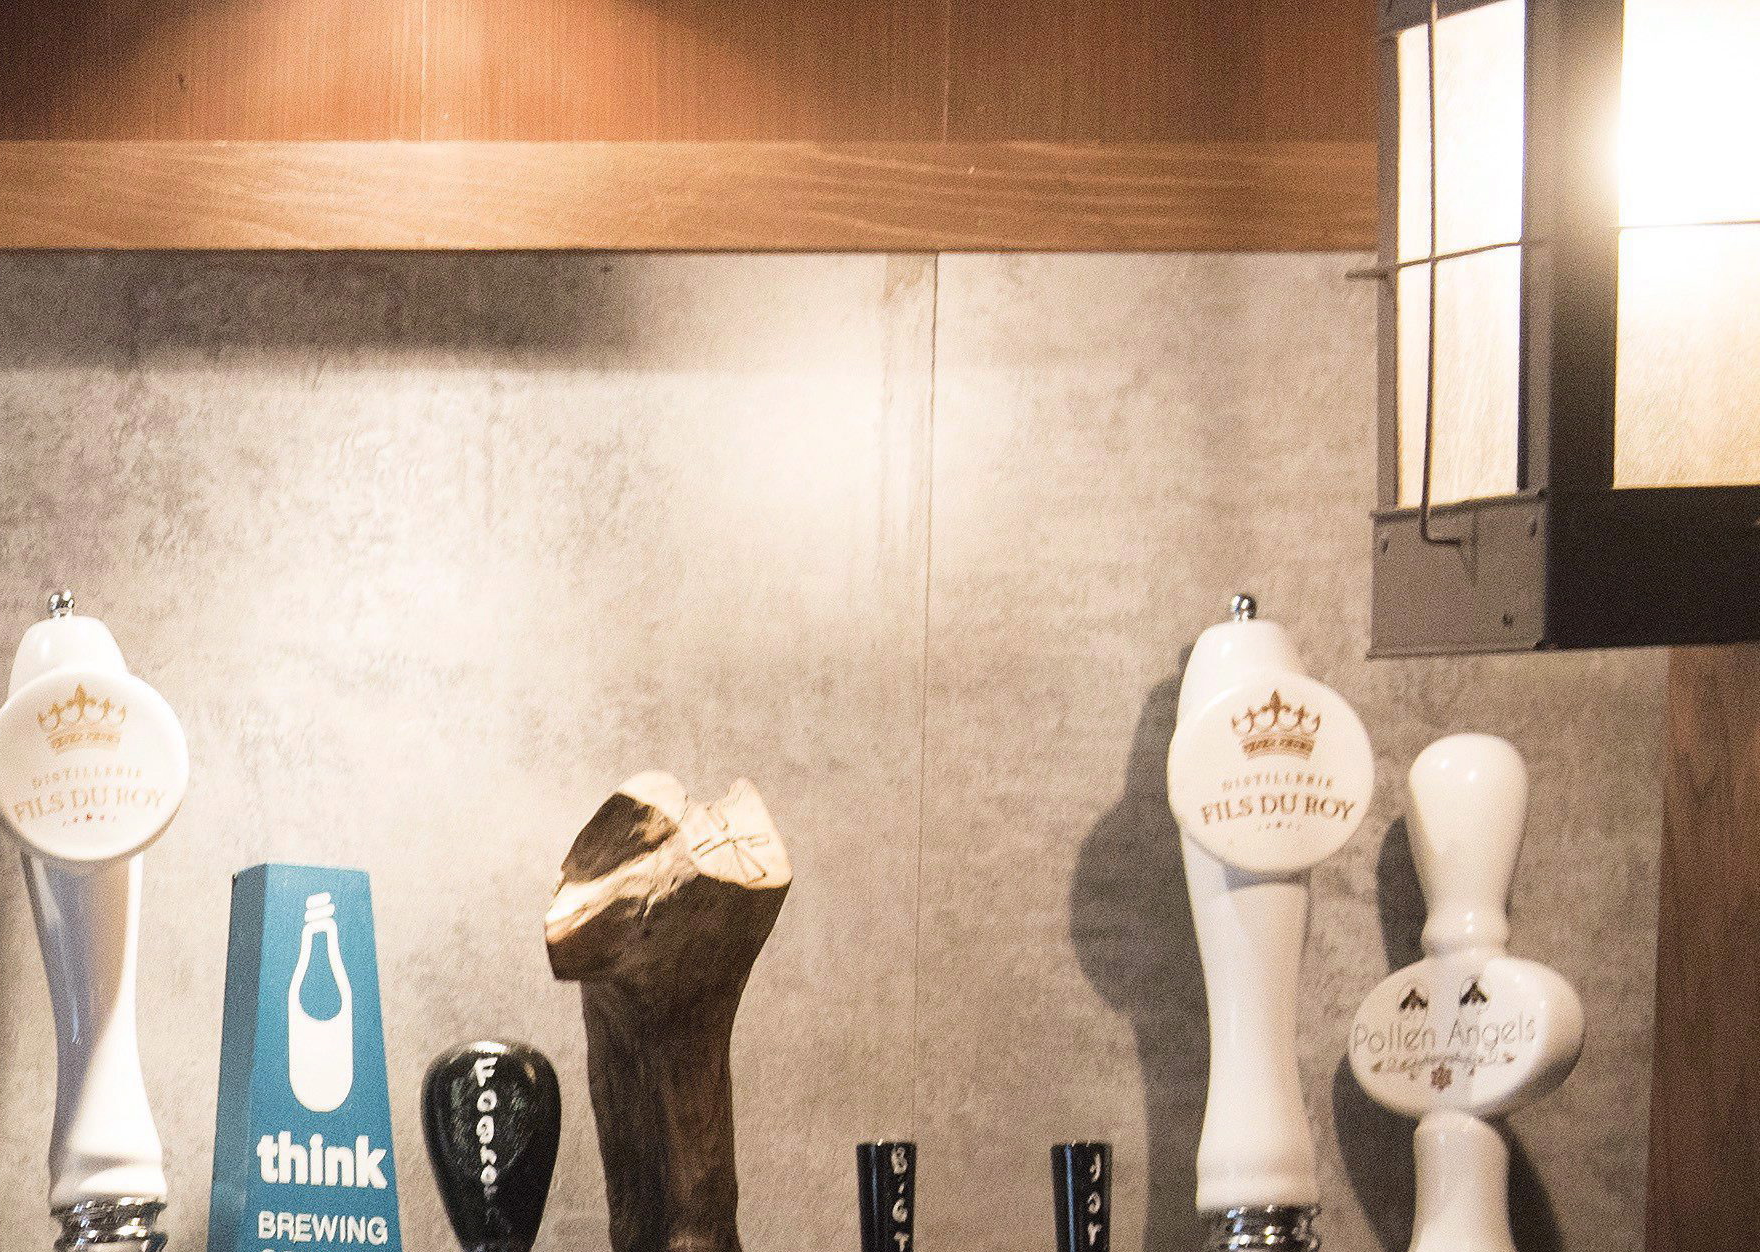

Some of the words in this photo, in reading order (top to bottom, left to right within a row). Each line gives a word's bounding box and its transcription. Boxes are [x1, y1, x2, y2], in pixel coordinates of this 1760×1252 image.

[13, 790, 66, 823] FILS
[70, 787, 108, 809] DU
[116, 787, 167, 809] ROY
[1201, 796, 1255, 825] FILS
[1260, 792, 1299, 815] DU
[1305, 794, 1355, 822] ROY
[1353, 1020, 1437, 1054] Pollen
[1446, 1011, 1536, 1052] Angels
[256, 1130, 388, 1189] think
[257, 1210, 389, 1246] BREWING
